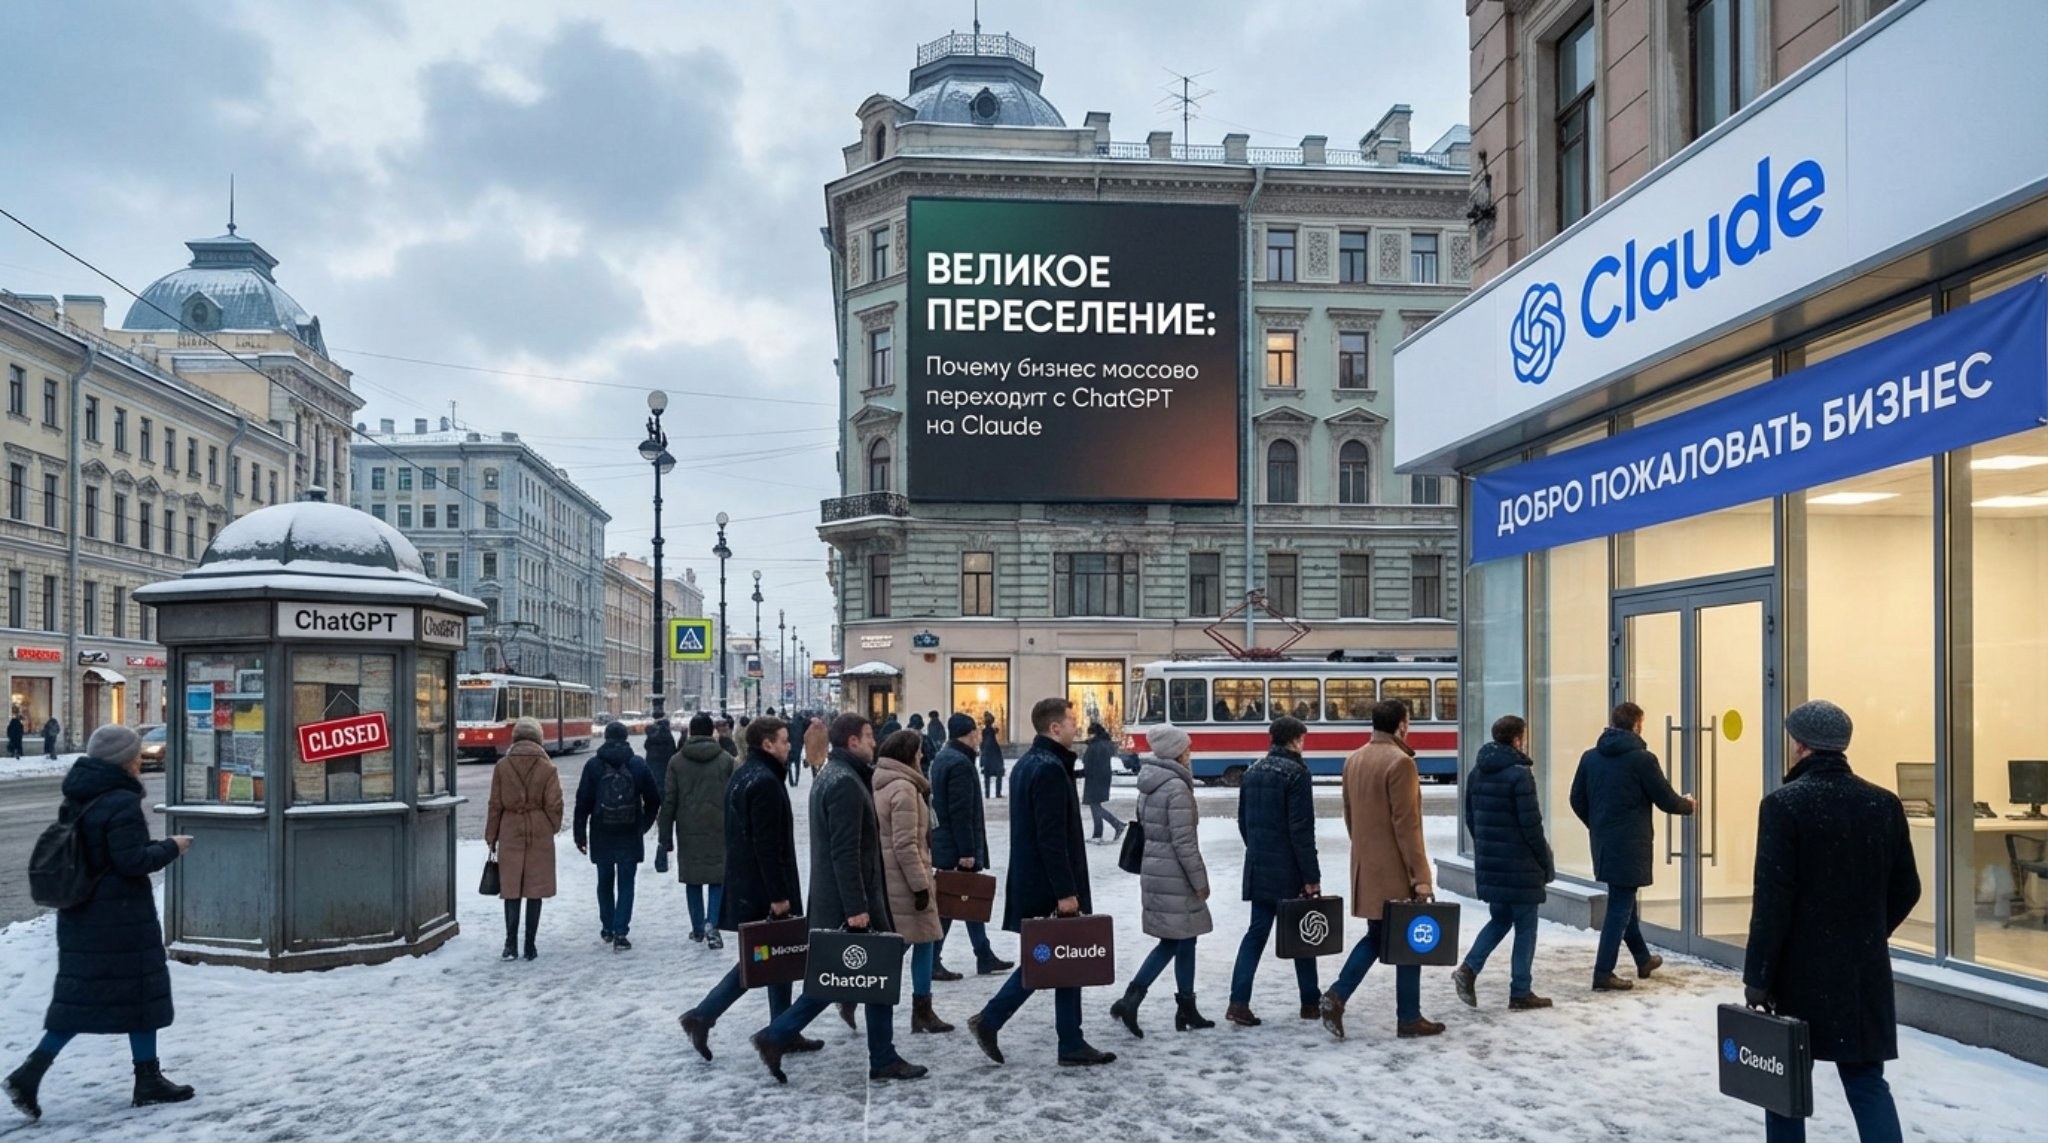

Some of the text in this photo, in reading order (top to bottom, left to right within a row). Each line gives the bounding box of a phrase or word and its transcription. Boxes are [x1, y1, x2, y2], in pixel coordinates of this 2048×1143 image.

[1581, 157, 1825, 338] Claude
[928, 252, 1110, 288] ВЕЛИКОЕ
[928, 299, 1216, 336] ПЕРЕСЕЛЕНИЕ:
[926, 355, 1199, 382] Почему бизнес массово
[1053, 392, 1066, 407] с
[1073, 387, 1174, 408] ChatGPT
[926, 414, 1042, 436] на Claude
[1498, 352, 1992, 537] ДОБРО ПОЖАЛОВАТЬ БИЗНЕС
[295, 609, 398, 632] ChatGPT
[308, 722, 380, 753] CLOSED
[1054, 943, 1107, 959] Claude
